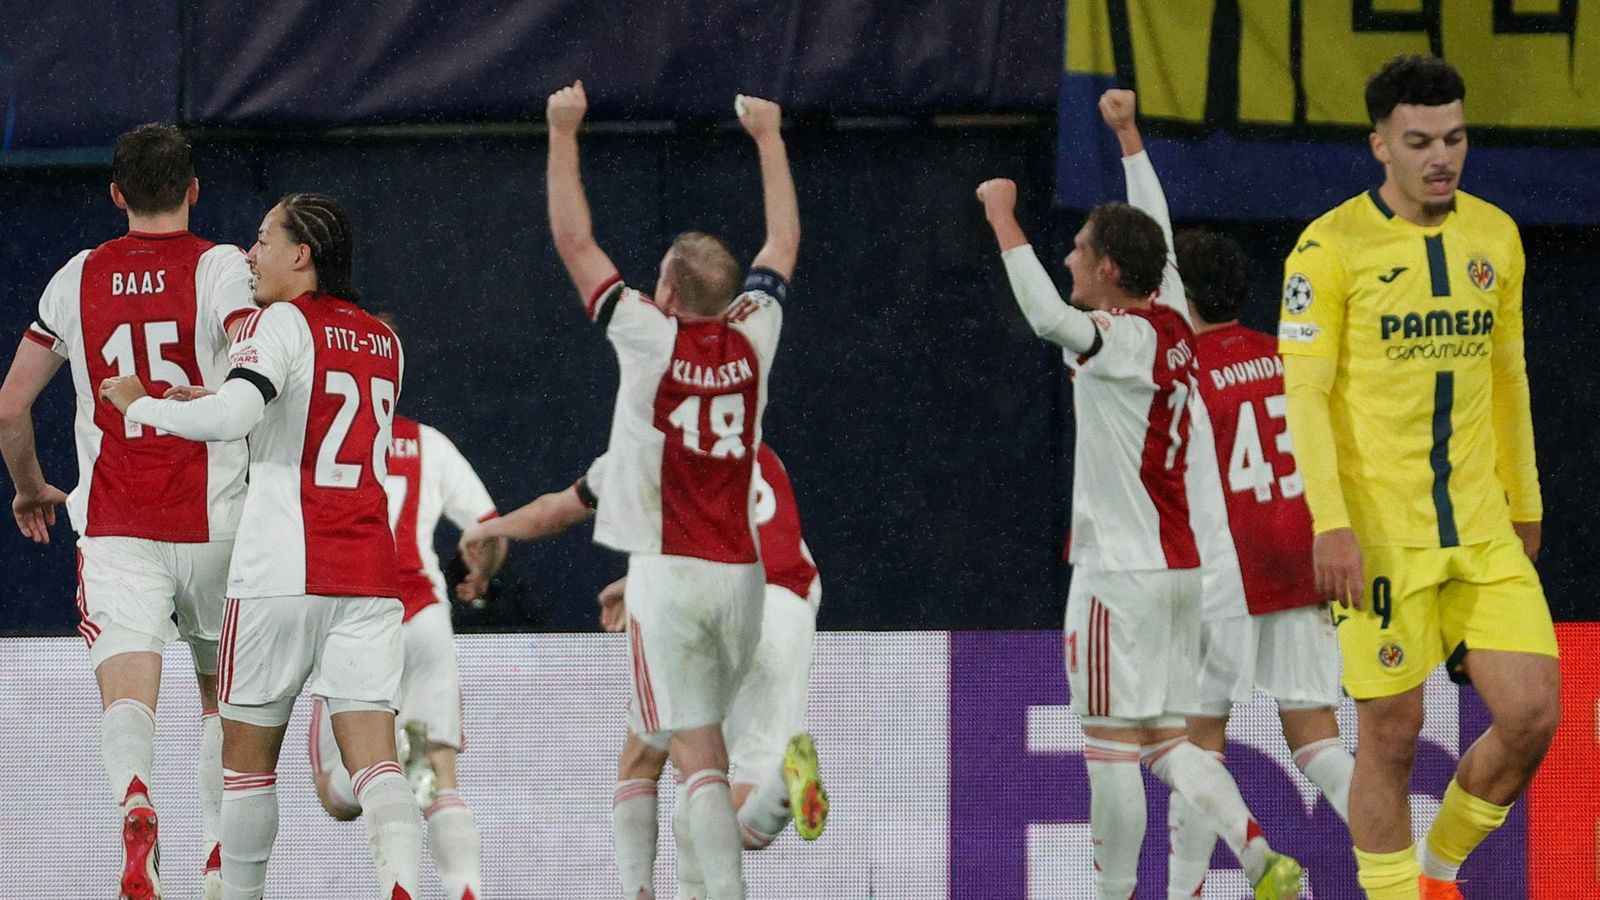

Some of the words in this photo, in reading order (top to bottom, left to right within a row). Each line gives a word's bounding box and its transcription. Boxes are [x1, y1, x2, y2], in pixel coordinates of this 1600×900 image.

[112, 269, 166, 296] BAAS
[325, 325, 393, 360] FITZ-JIM
[1381, 309, 1495, 340] PAMESA
[101, 321, 192, 439] 15
[672, 357, 754, 389] KLAASEN
[315, 371, 396, 489] 28
[668, 393, 746, 459] 18
[1228, 394, 1304, 504] 43
[1371, 575, 1392, 630] 9
